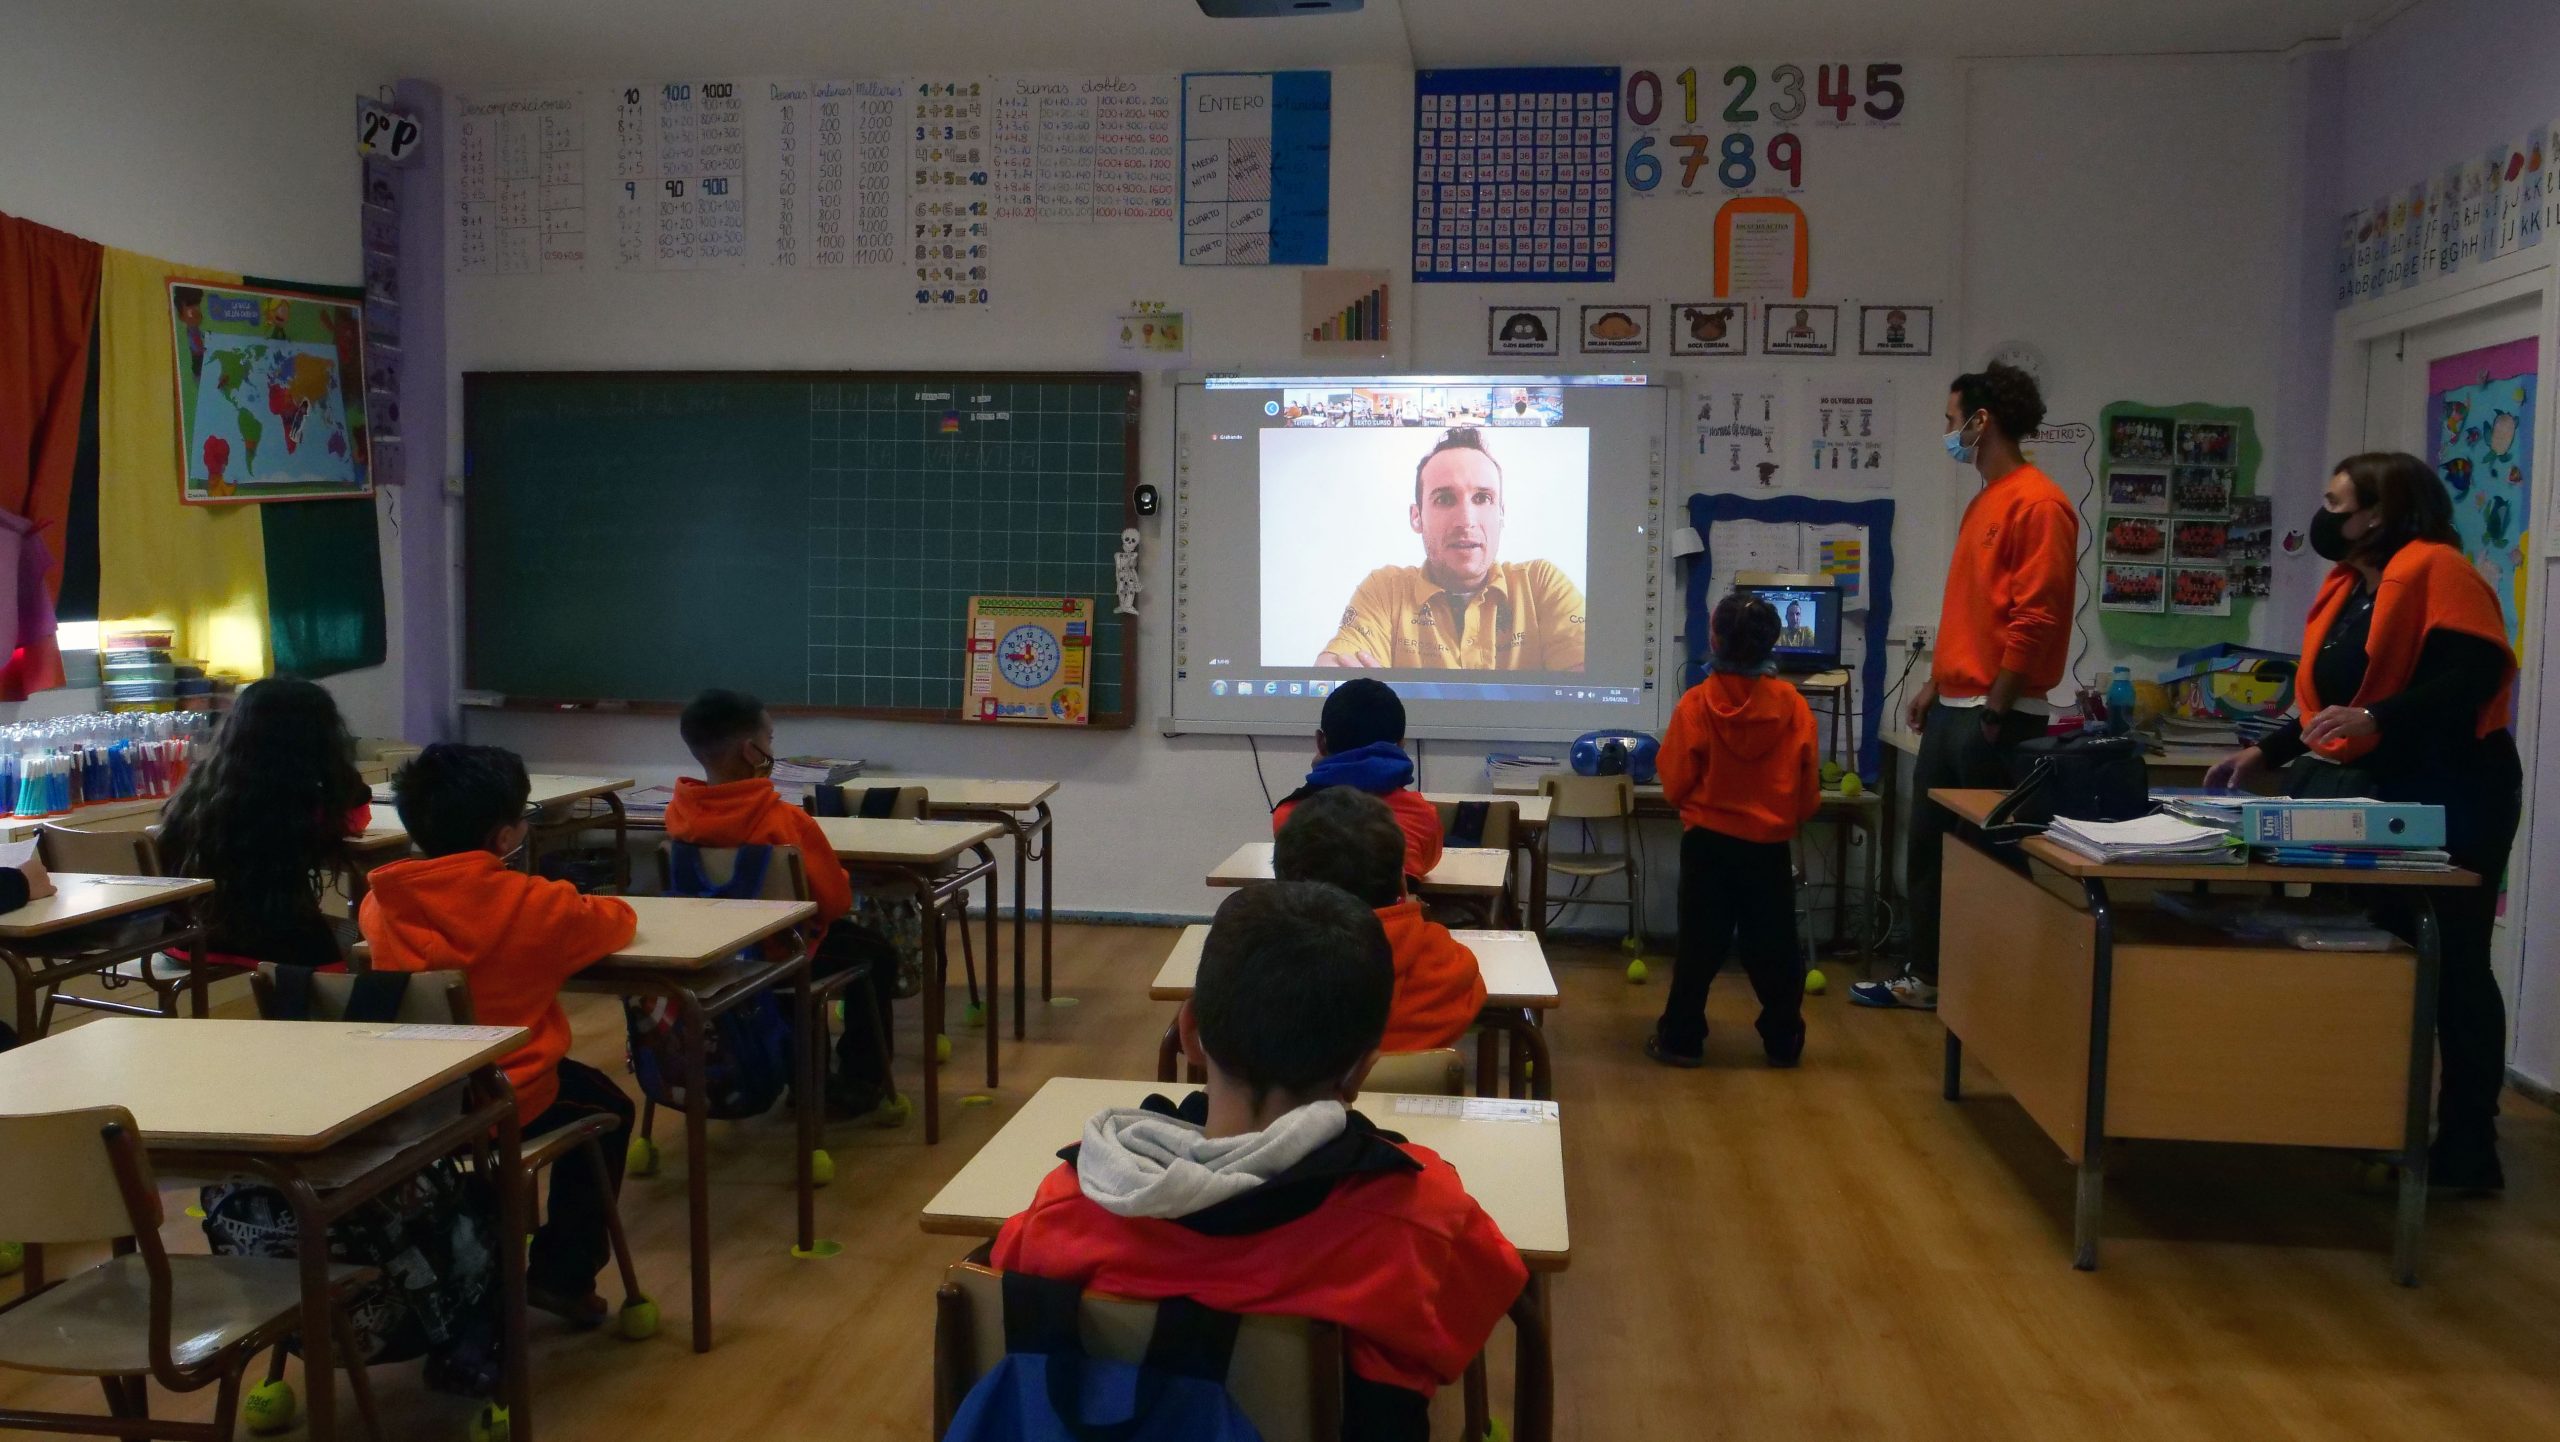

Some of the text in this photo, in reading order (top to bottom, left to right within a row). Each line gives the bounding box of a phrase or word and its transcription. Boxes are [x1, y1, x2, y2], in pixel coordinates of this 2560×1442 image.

[624, 83, 733, 105] 10 100 1000
[1199, 94, 1265, 113] ENTERO
[1626, 62, 1905, 126] 0 1 2 3 4 5
[1625, 132, 1802, 191] 6 7 8 9
[625, 177, 729, 201] 9 90 900
[1187, 208, 1264, 229] CUARTO CUARTO
[1189, 239, 1223, 257] CUARTO
[1008, 641, 1015, 649] 10
[1026, 631, 1034, 639] 12
[2263, 815, 2275, 837] Uni
